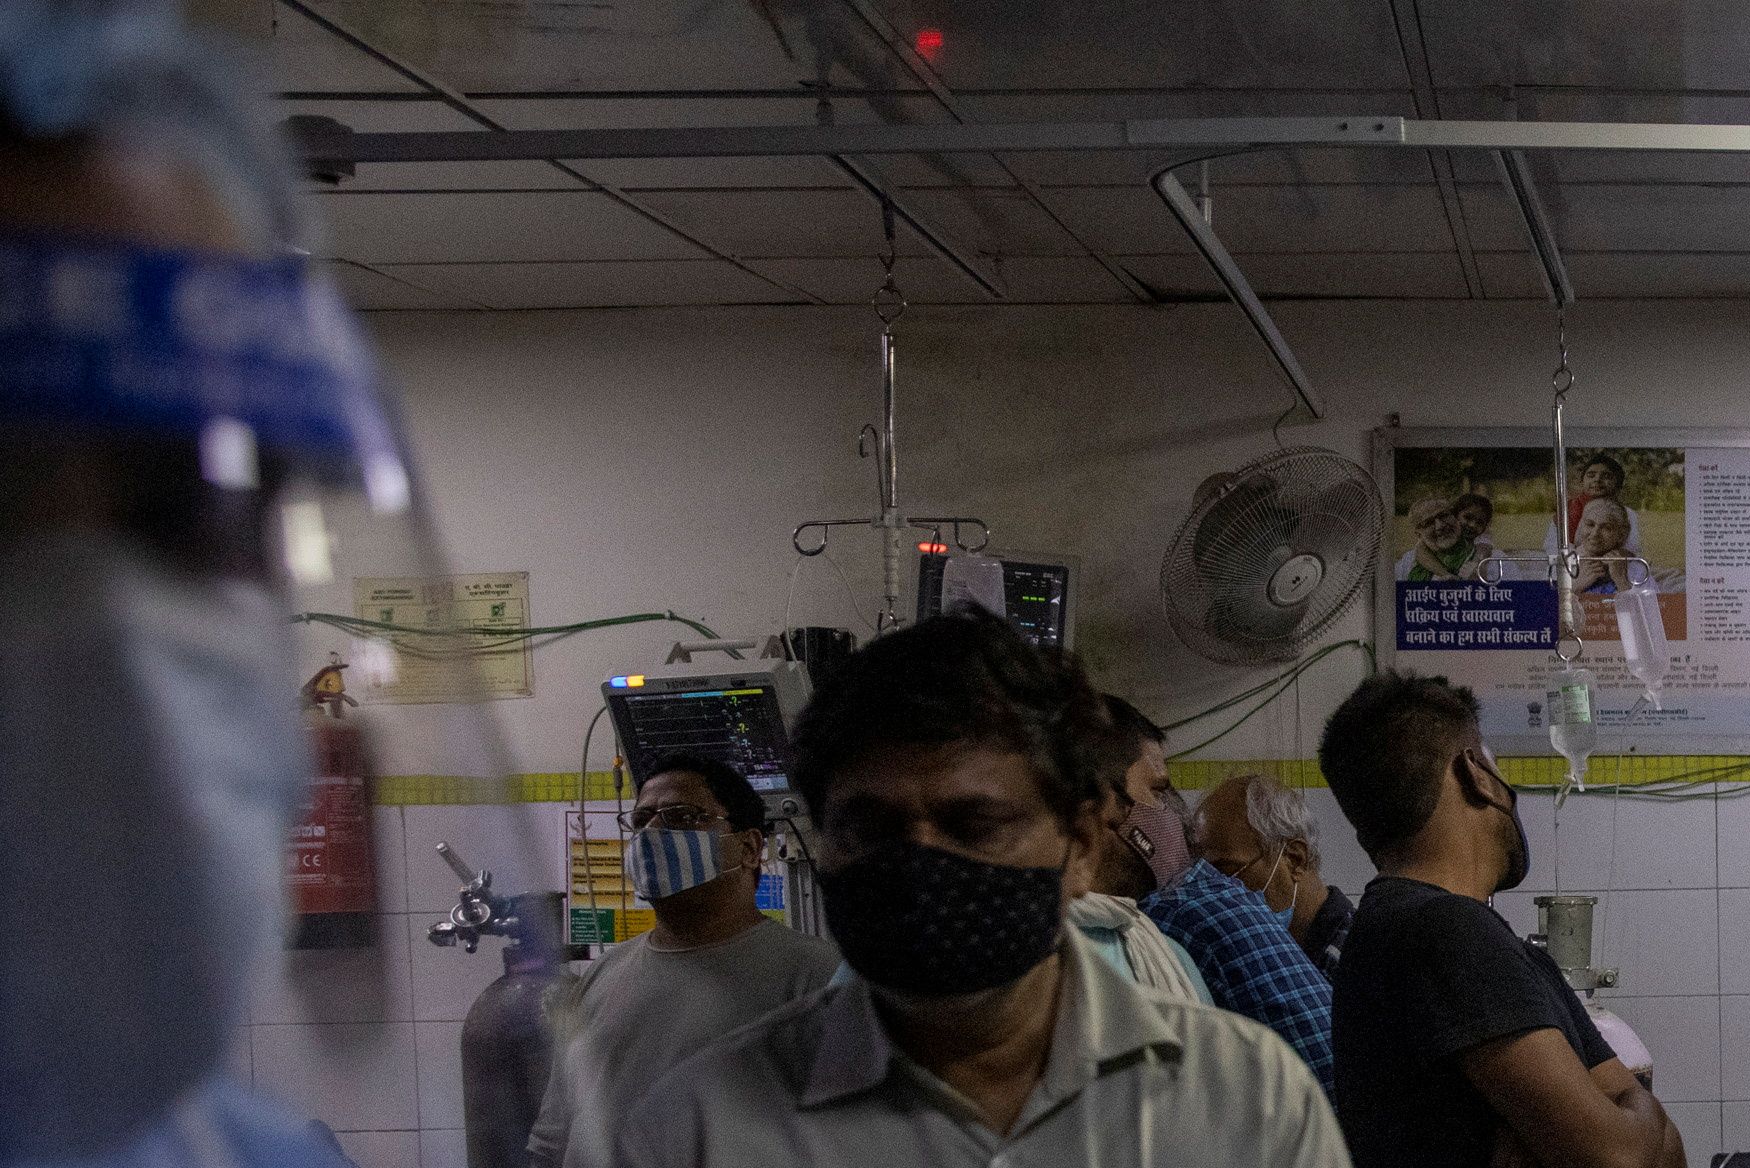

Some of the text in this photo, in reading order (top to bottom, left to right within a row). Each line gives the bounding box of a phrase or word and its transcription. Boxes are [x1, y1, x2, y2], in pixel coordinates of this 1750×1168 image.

[1406, 585, 1513, 607] आईए बुजुर्गों के लिए
[1406, 607, 1440, 624] सक्रिय
[1442, 607, 1459, 622] एवं
[1406, 627, 1552, 646] बनाने का हम सभी संकल्प लें
[303, 855, 321, 867] CE
